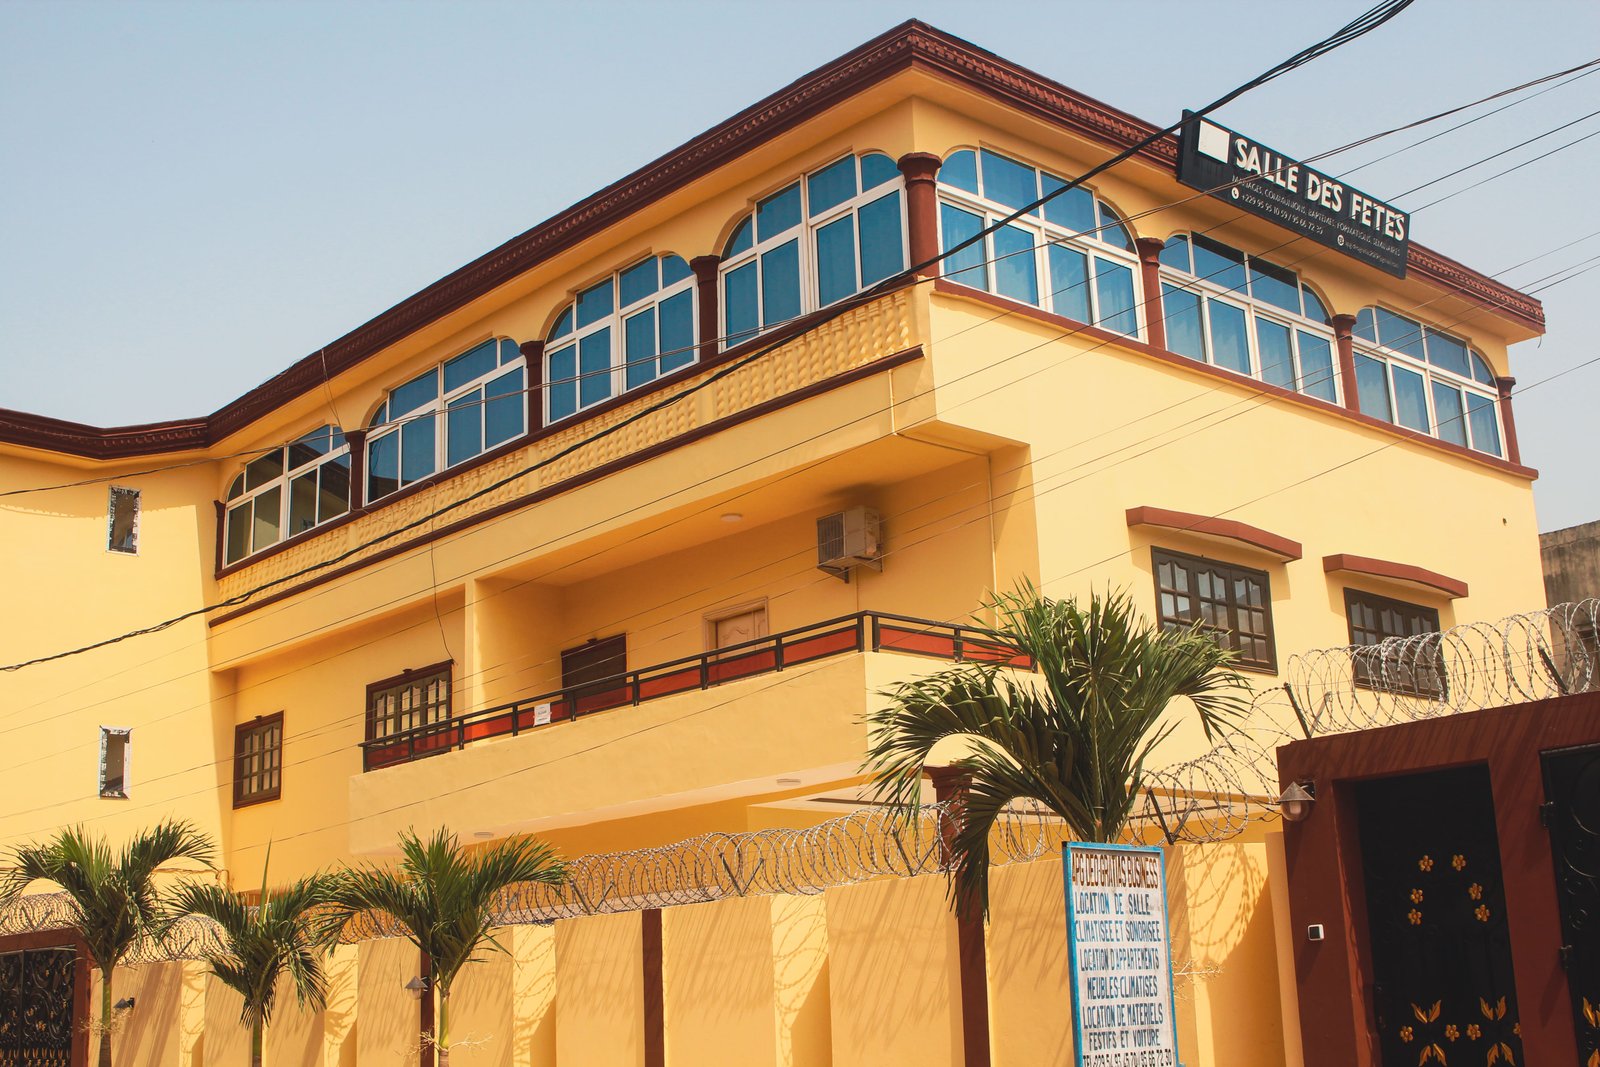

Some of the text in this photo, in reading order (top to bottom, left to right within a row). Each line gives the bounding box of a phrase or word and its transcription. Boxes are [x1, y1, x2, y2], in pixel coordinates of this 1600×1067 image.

[1234, 138, 1404, 241] SALLE DES FETES
[1128, 856, 1158, 889] BUSINESS
[1075, 892, 1151, 916] LOCATION DE SALLE
[1075, 920, 1162, 942] CLIMATISEE ET SONORISEE
[1080, 948, 1108, 972] LOCATION
[1082, 1002, 1164, 1029] LOCATION DE MATERIELS
[1088, 1028, 1160, 1051] FESTIFS ET VOITURE
